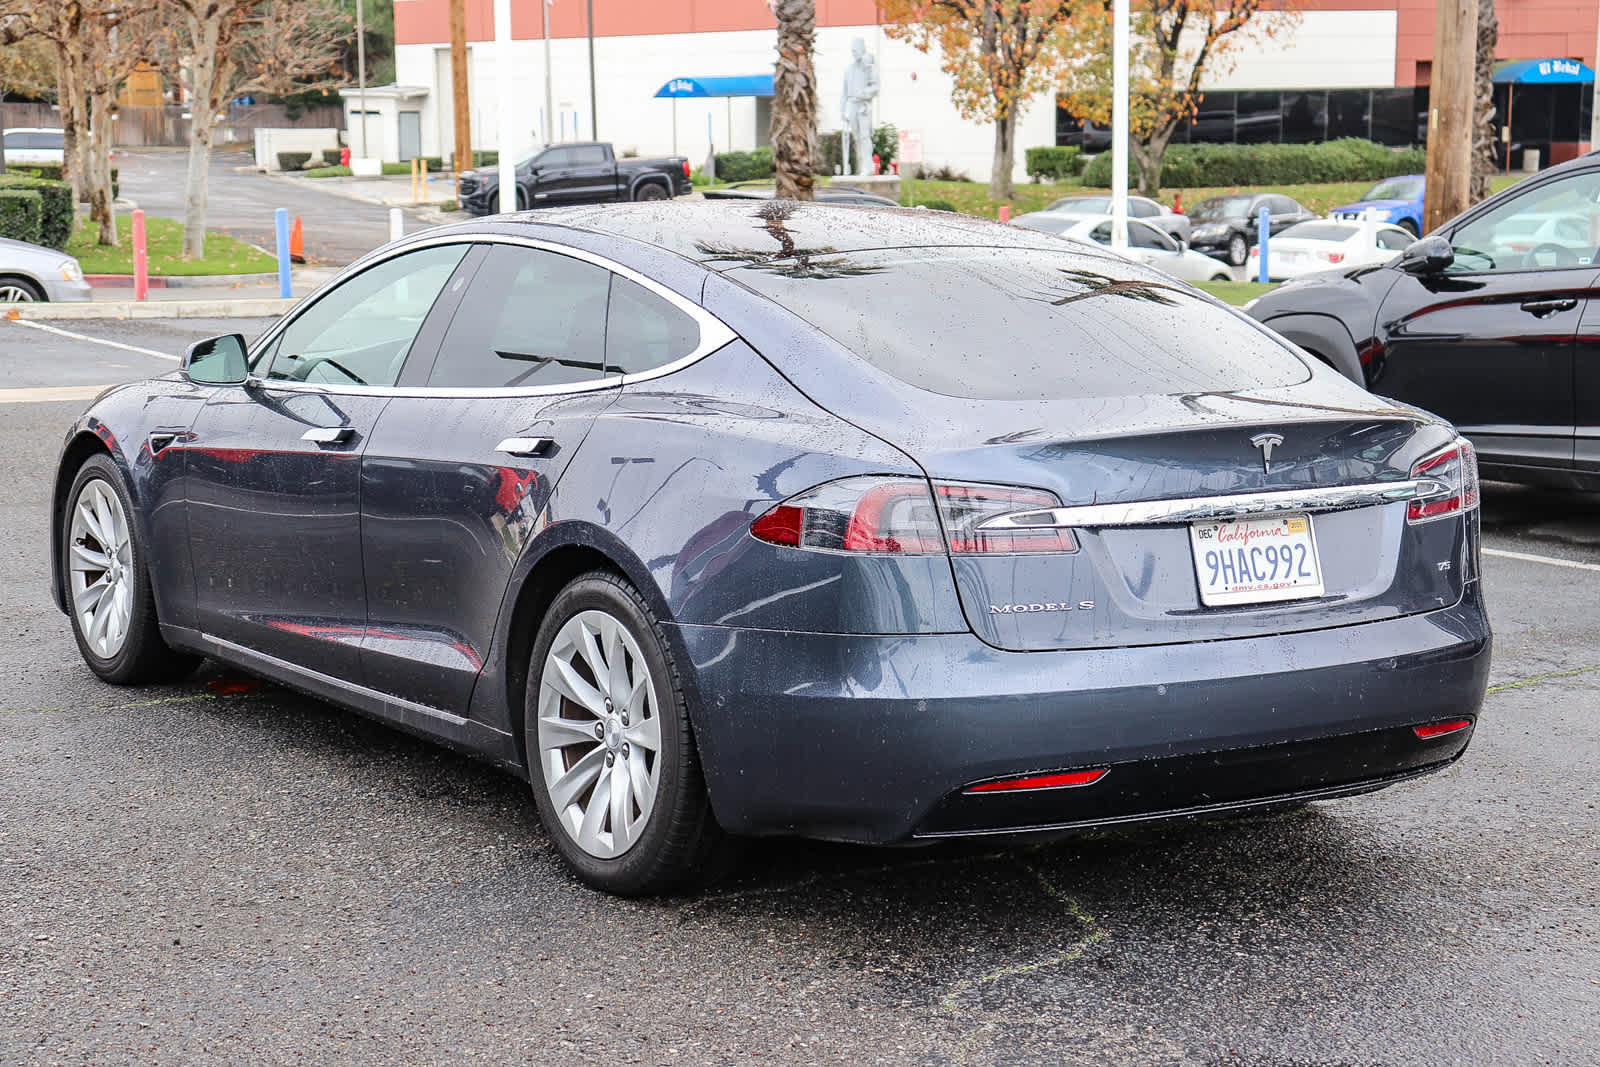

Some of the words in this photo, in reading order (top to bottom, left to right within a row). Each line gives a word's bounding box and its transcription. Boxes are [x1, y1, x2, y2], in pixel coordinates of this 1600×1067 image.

[1198, 529, 1213, 540] DEC
[1218, 524, 1283, 545] California
[1206, 543, 1311, 586] 9HAC992
[1437, 560, 1451, 571] 75
[988, 602, 1073, 615] MODEL
[1079, 600, 1096, 610] S
